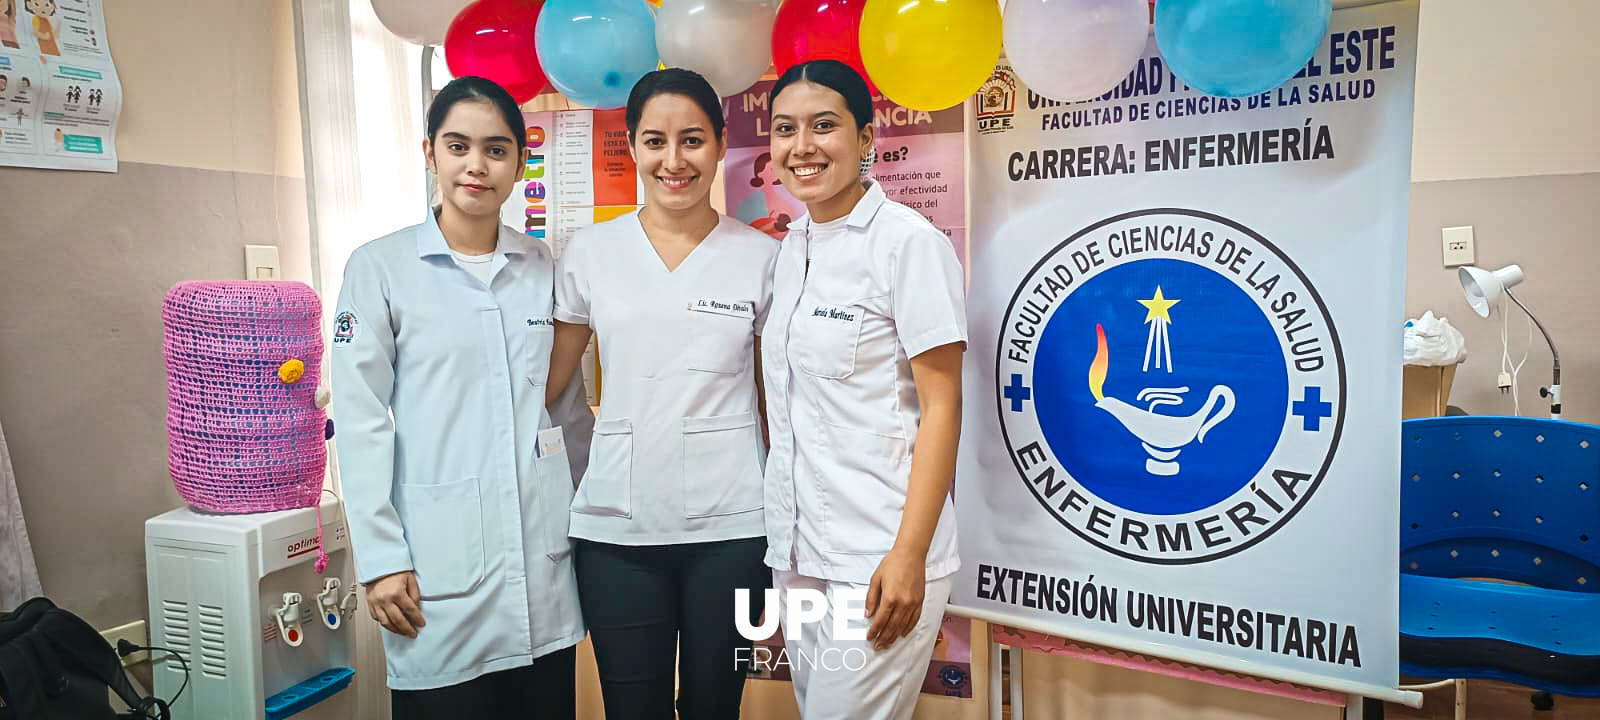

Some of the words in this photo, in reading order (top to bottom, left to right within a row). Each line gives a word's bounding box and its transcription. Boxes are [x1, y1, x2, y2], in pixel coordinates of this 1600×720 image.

[1330, 26, 1396, 75] ESTE
[979, 118, 1011, 129] UPE
[1041, 106, 1123, 130] FACULTAD
[1129, 103, 1150, 122] DE
[1156, 95, 1241, 119] CIENCIAS
[1248, 91, 1271, 110] DE
[1278, 86, 1302, 106] LA
[1308, 78, 1376, 103] SALUD
[882, 146, 909, 162] es?
[1008, 142, 1136, 183] CARRERA:
[1143, 117, 1335, 173] ENFERMERÍA
[900, 184, 948, 195] efectividad
[925, 171, 942, 181] que
[925, 199, 938, 208] del
[1008, 264, 1074, 364] FACULTAD
[1071, 241, 1105, 275] DE
[1108, 225, 1214, 259] CIENCIAS
[1215, 238, 1253, 275] DE
[1245, 260, 1281, 300] LA
[1271, 291, 1325, 373] SALUD
[1016, 441, 1313, 553] ENFERMERÍA
[976, 563, 1118, 624] EXTENSIÓN
[1127, 590, 1362, 668] UNIVERSITARIA
